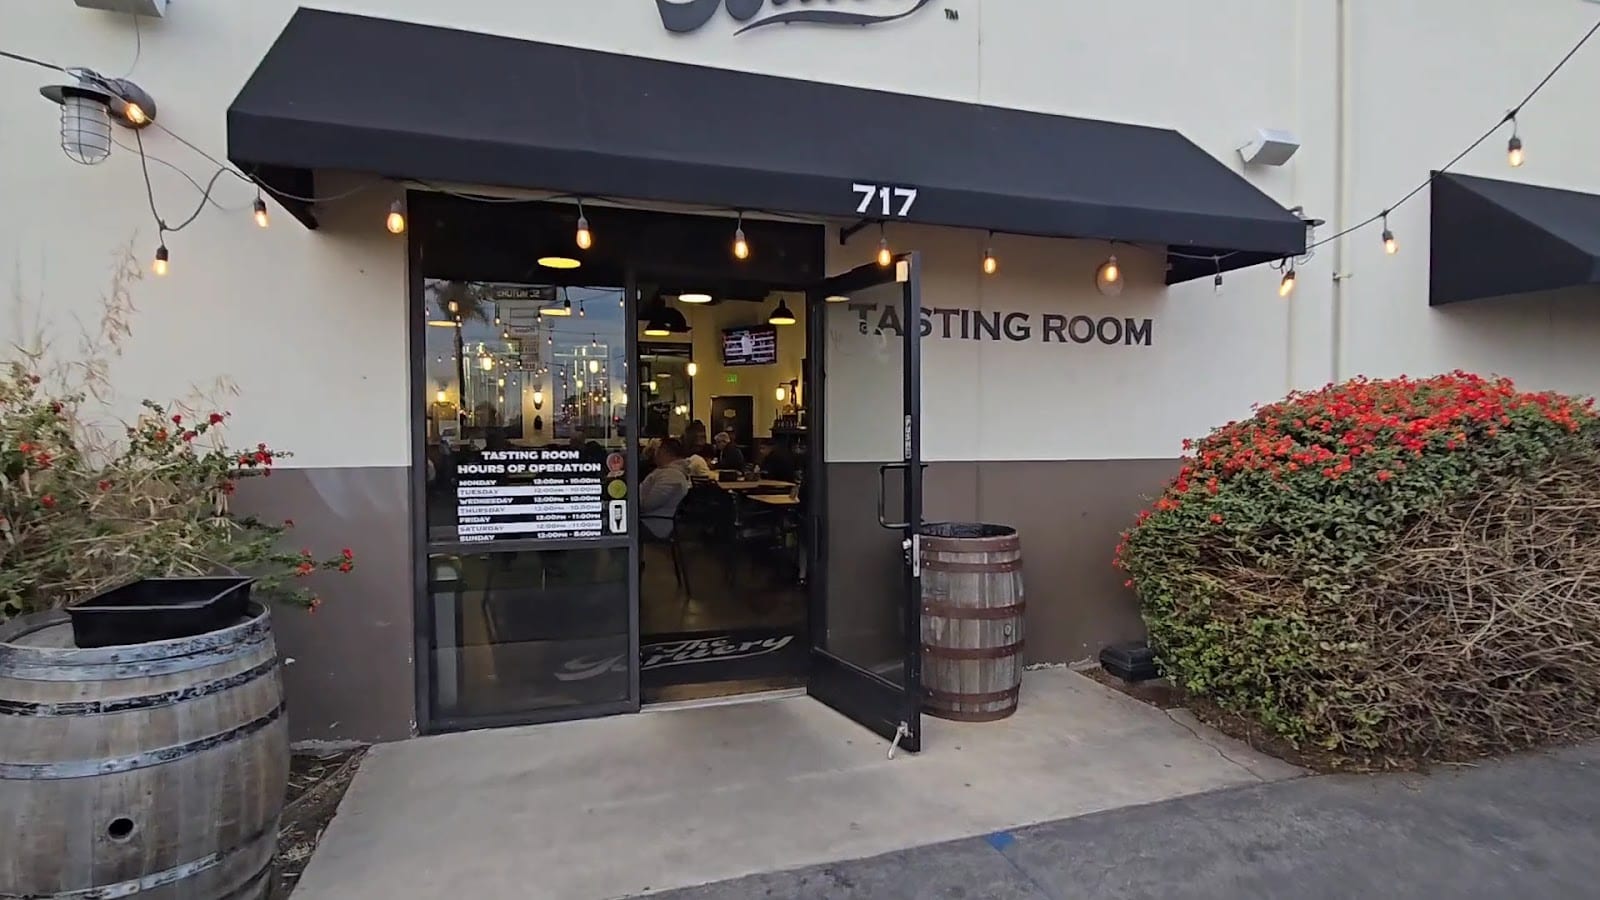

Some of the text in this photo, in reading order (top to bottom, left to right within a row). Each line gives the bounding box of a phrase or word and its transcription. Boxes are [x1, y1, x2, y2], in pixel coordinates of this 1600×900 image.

[853, 183, 917, 217] 717
[1042, 314, 1153, 346] ROOM
[481, 450, 579, 460] TASTING ROOM
[457, 464, 505, 474] HOURS
[507, 464, 525, 473] OF
[528, 463, 601, 473] OPERATION
[459, 497, 513, 505] WEDNESDAY
[460, 506, 505, 514] THURSDAY
[459, 534, 495, 542] SUNDAY
